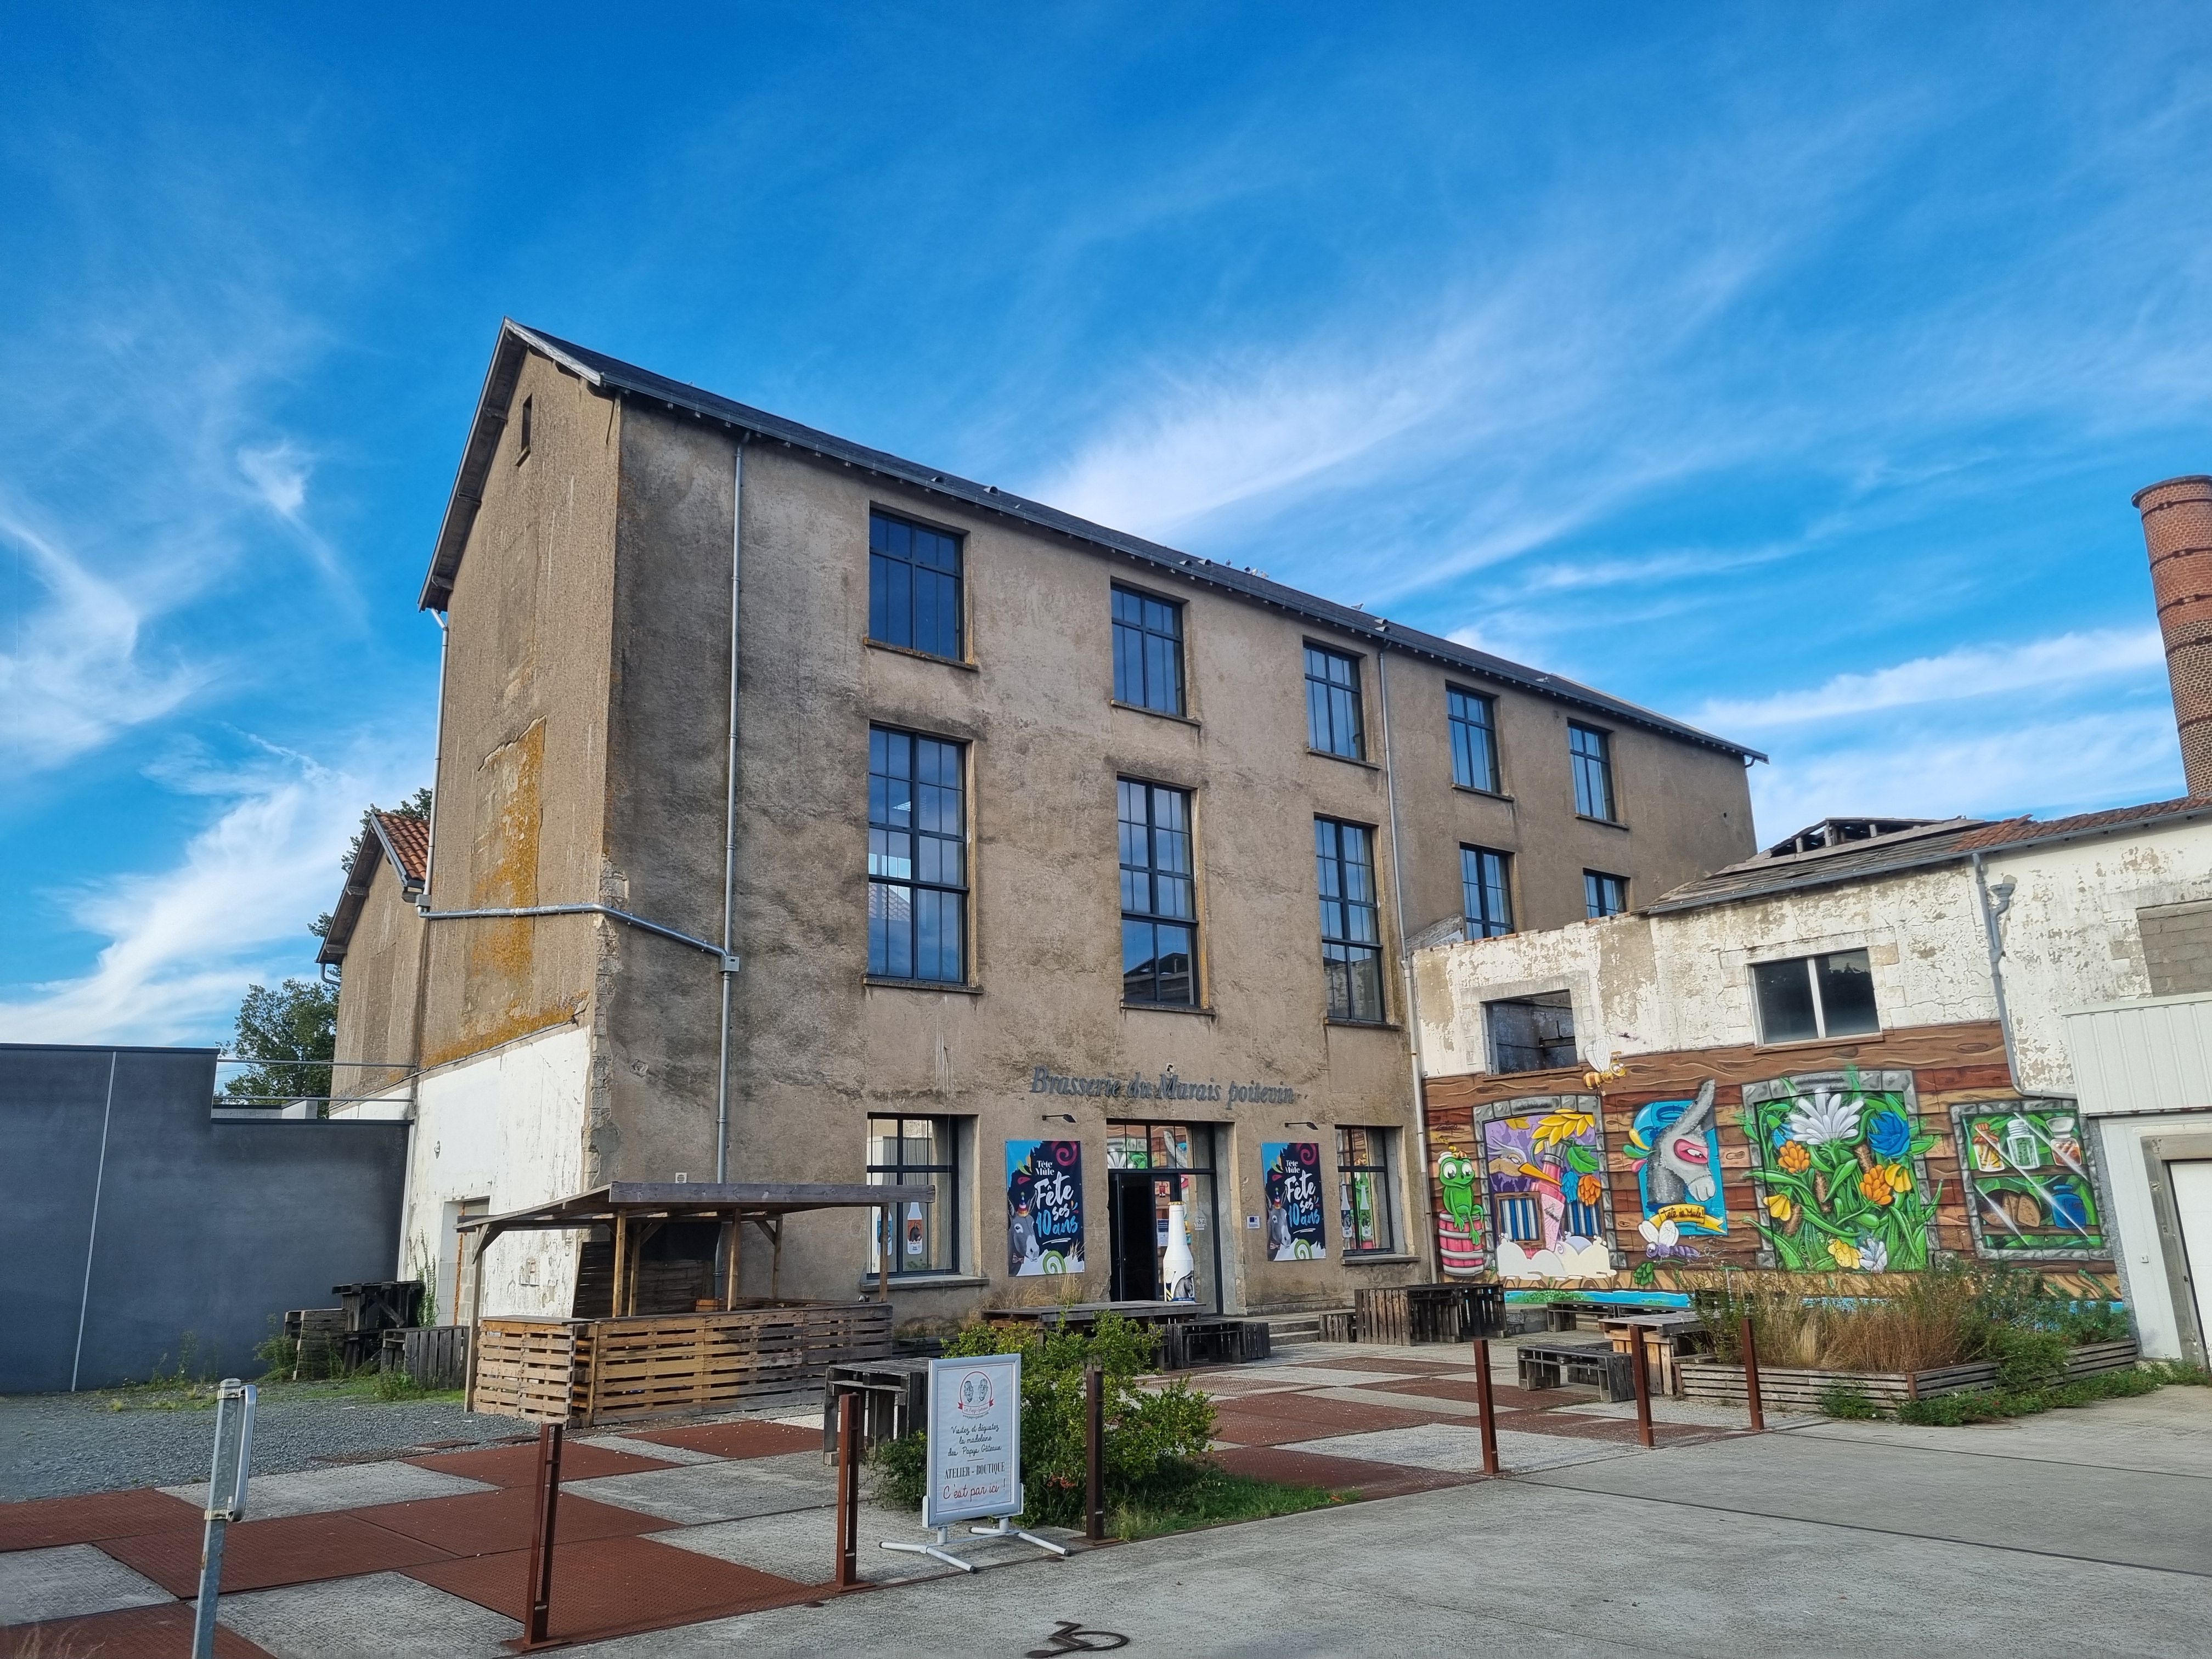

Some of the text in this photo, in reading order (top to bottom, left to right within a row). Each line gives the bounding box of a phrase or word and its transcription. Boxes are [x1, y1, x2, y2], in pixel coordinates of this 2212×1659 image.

[1030, 1066, 1295, 1110] Brasserie du Marais poitevin
[1034, 1171, 1074, 1209] Fête
[1284, 1170, 1316, 1203] Fête
[1052, 1203, 1070, 1221] ses
[1299, 1195, 1314, 1214] ses
[1036, 1209, 1079, 1238] 10 ans
[1288, 1203, 1321, 1228] 10 ans
[951, 1425, 970, 1435] Visitez
[978, 1423, 1000, 1434] dégustez
[959, 1434, 992, 1444] la madeleine
[947, 1444, 1002, 1457] des Papys Gâteaux
[944, 1466, 970, 1480] ATELIER
[976, 1462, 1005, 1475] BOUTIQUE
[943, 1483, 968, 1499] C'est
[970, 1487, 987, 1502] par
[989, 1482, 1000, 1493] ici
